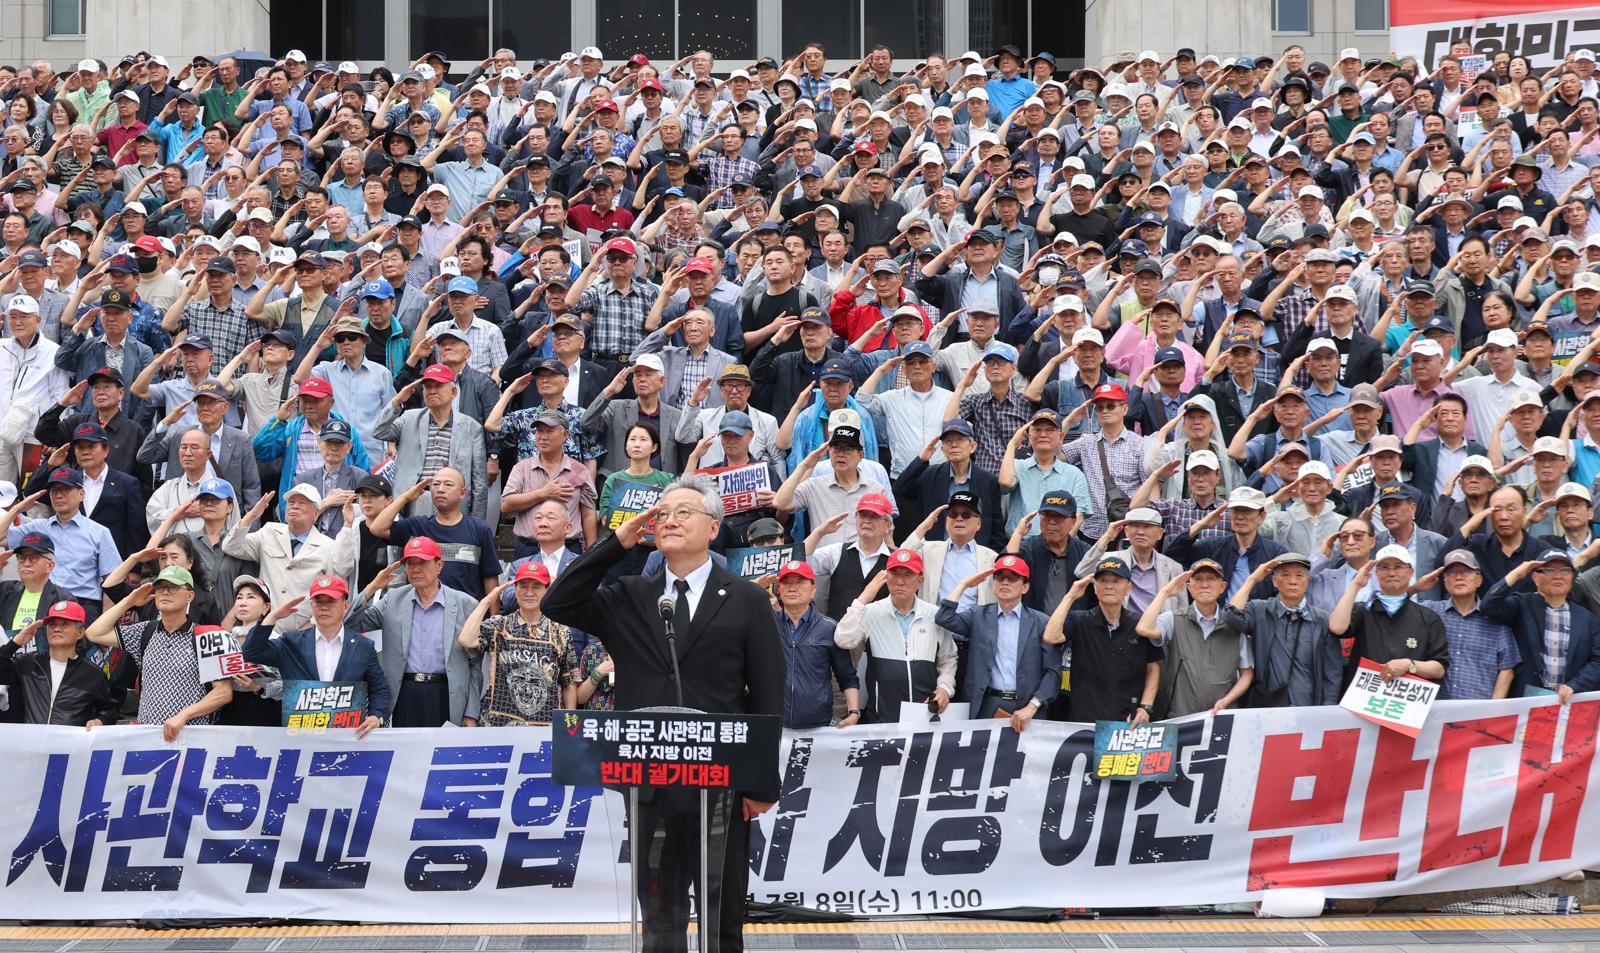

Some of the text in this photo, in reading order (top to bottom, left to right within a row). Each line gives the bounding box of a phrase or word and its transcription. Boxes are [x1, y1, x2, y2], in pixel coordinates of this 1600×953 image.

[274, 249, 286, 257] NA
[12, 298, 25, 306] NA
[198, 383, 217, 391] KMA
[836, 429, 855, 438] KMA
[723, 468, 767, 494] 자해행위
[722, 494, 752, 511] 중단
[954, 494, 973, 502] KMA
[1045, 497, 1067, 506] KMA
[1099, 560, 1121, 569] KMA
[200, 634, 224, 658] 안보
[294, 686, 354, 712] 사관학교
[1355, 672, 1434, 705] 태릉 안보성지
[1364, 695, 1406, 720] 보존
[331, 711, 363, 732] 반대
[583, 718, 748, 744] 육·해·공군 사관학교 통합
[1106, 727, 1165, 752] 사관학교
[618, 744, 713, 761] 육사 지방 이전
[1097, 750, 1172, 778] 통폐합 반대
[600, 761, 730, 787] 반대 궐기대회
[6, 745, 392, 893] 사관학교
[404, 741, 604, 892] 통합
[822, 726, 1026, 877] 지방
[1038, 715, 1234, 867] 이전
[1247, 700, 1600, 892] 반대
[815, 888, 900, 914] 8일(수)
[911, 888, 983, 910] 11:00
